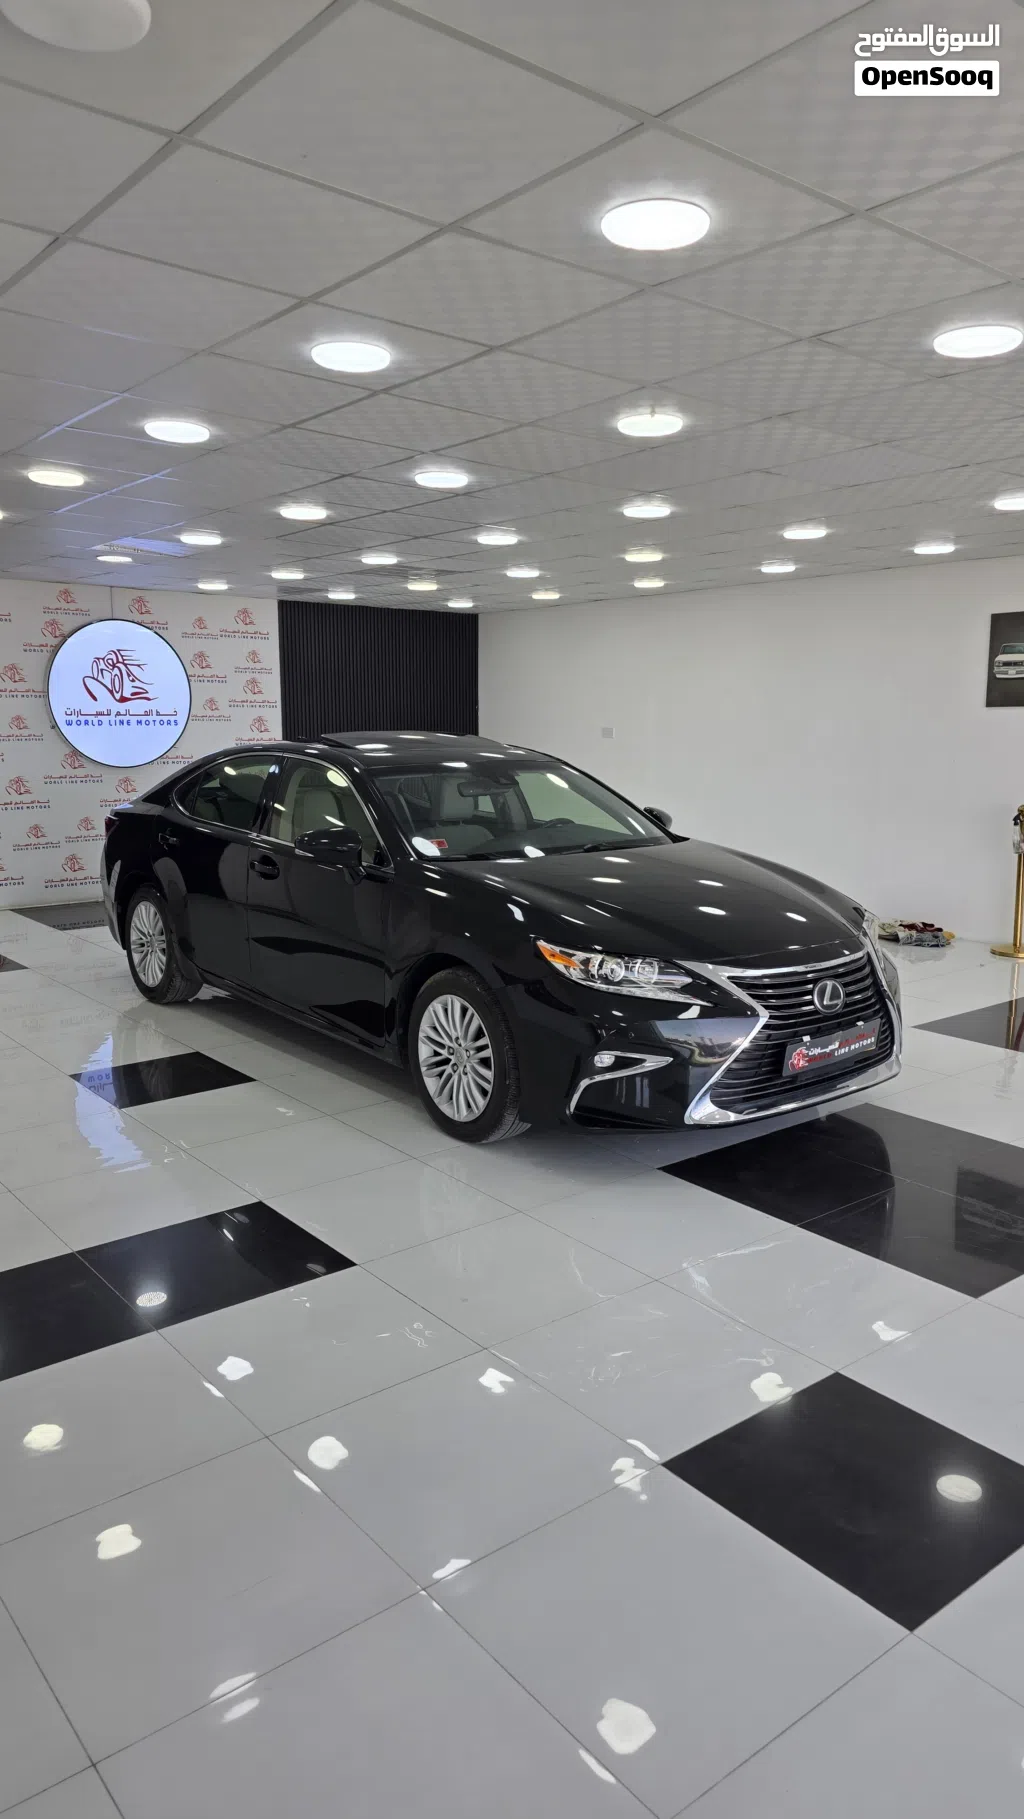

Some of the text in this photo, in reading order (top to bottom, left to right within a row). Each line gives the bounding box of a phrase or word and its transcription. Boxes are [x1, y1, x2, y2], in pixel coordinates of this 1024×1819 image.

[65, 707, 178, 719] خط العالم للسيارات
[834, 1046, 849, 1057] LINE
[850, 1036, 875, 1051] MOTORS
